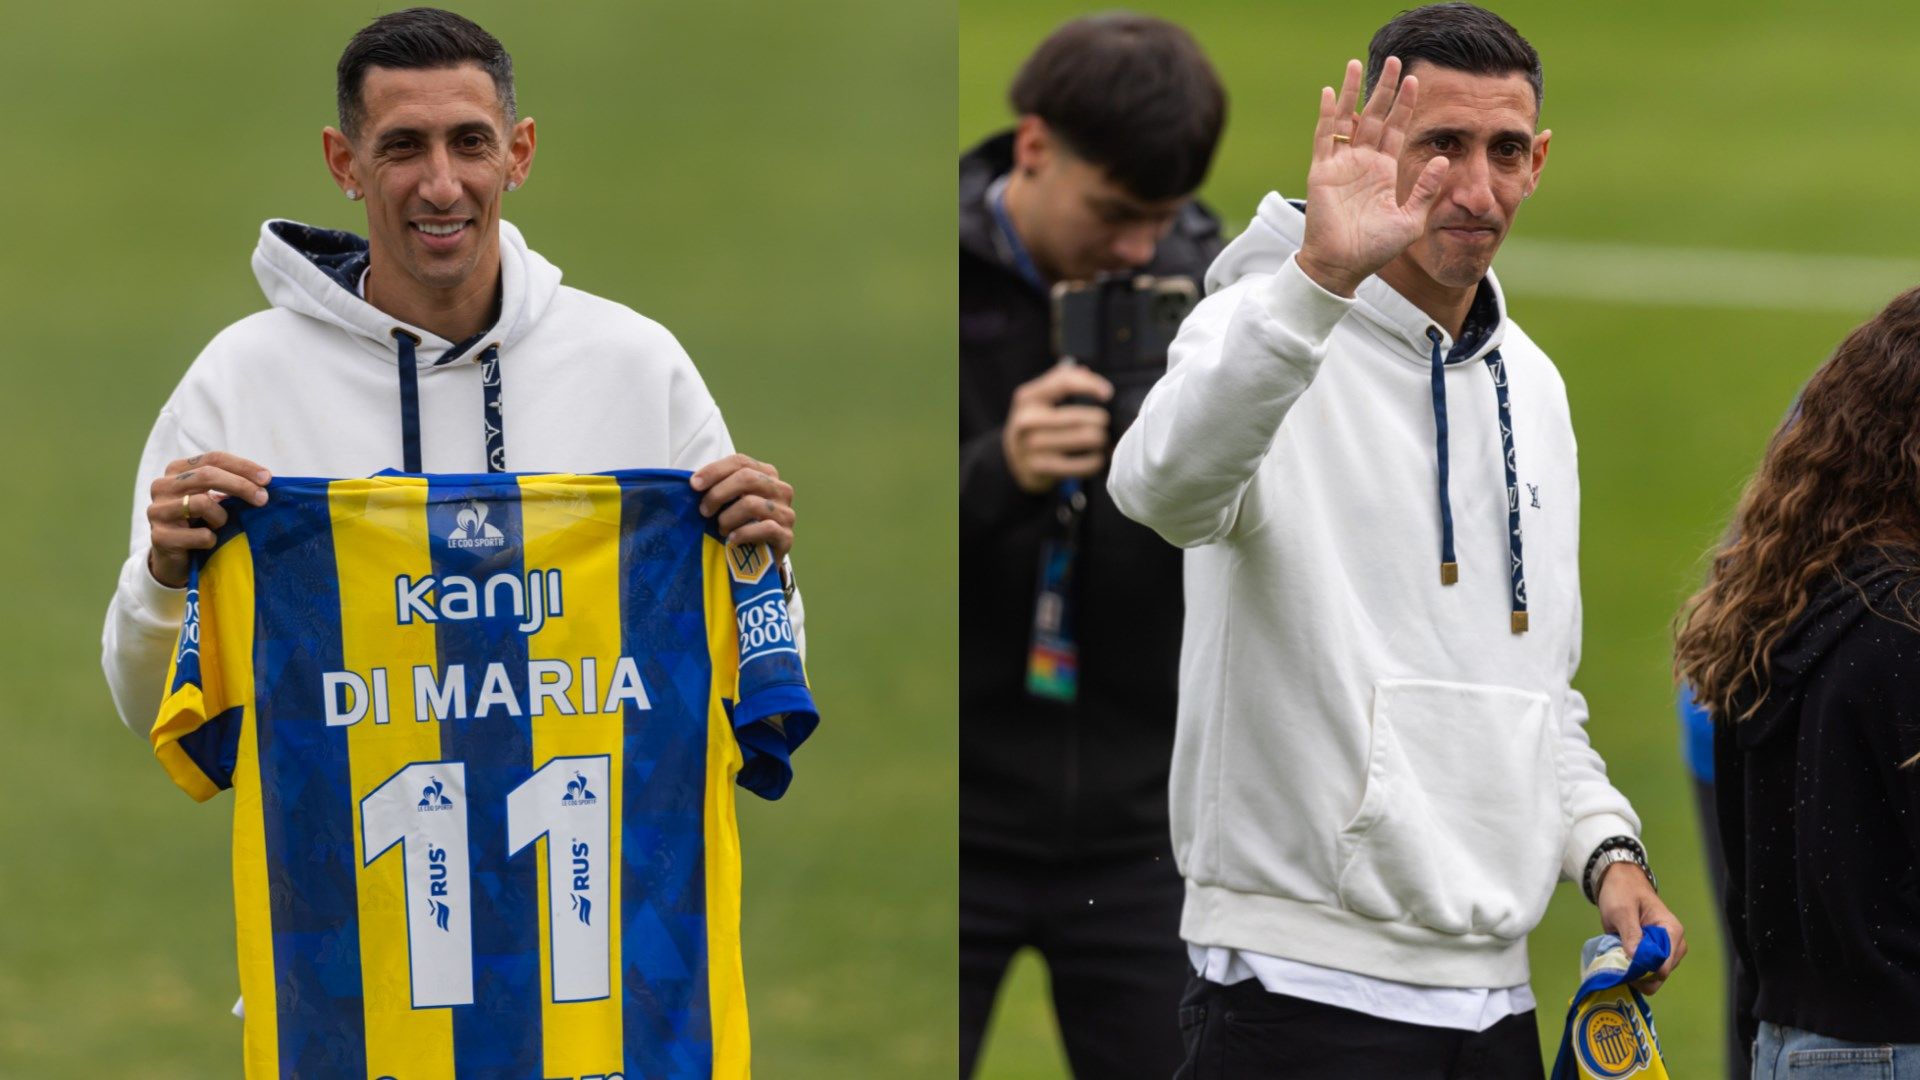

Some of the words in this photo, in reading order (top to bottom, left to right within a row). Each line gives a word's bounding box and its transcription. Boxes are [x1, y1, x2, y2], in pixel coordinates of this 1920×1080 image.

[447, 540, 456, 549] LE
[457, 539, 473, 548] COQ
[474, 538, 505, 547] SPORTIF
[737, 599, 788, 634] VOSS
[740, 620, 792, 656] 2000
[322, 667, 391, 727] DI
[412, 656, 653, 723] MARIA
